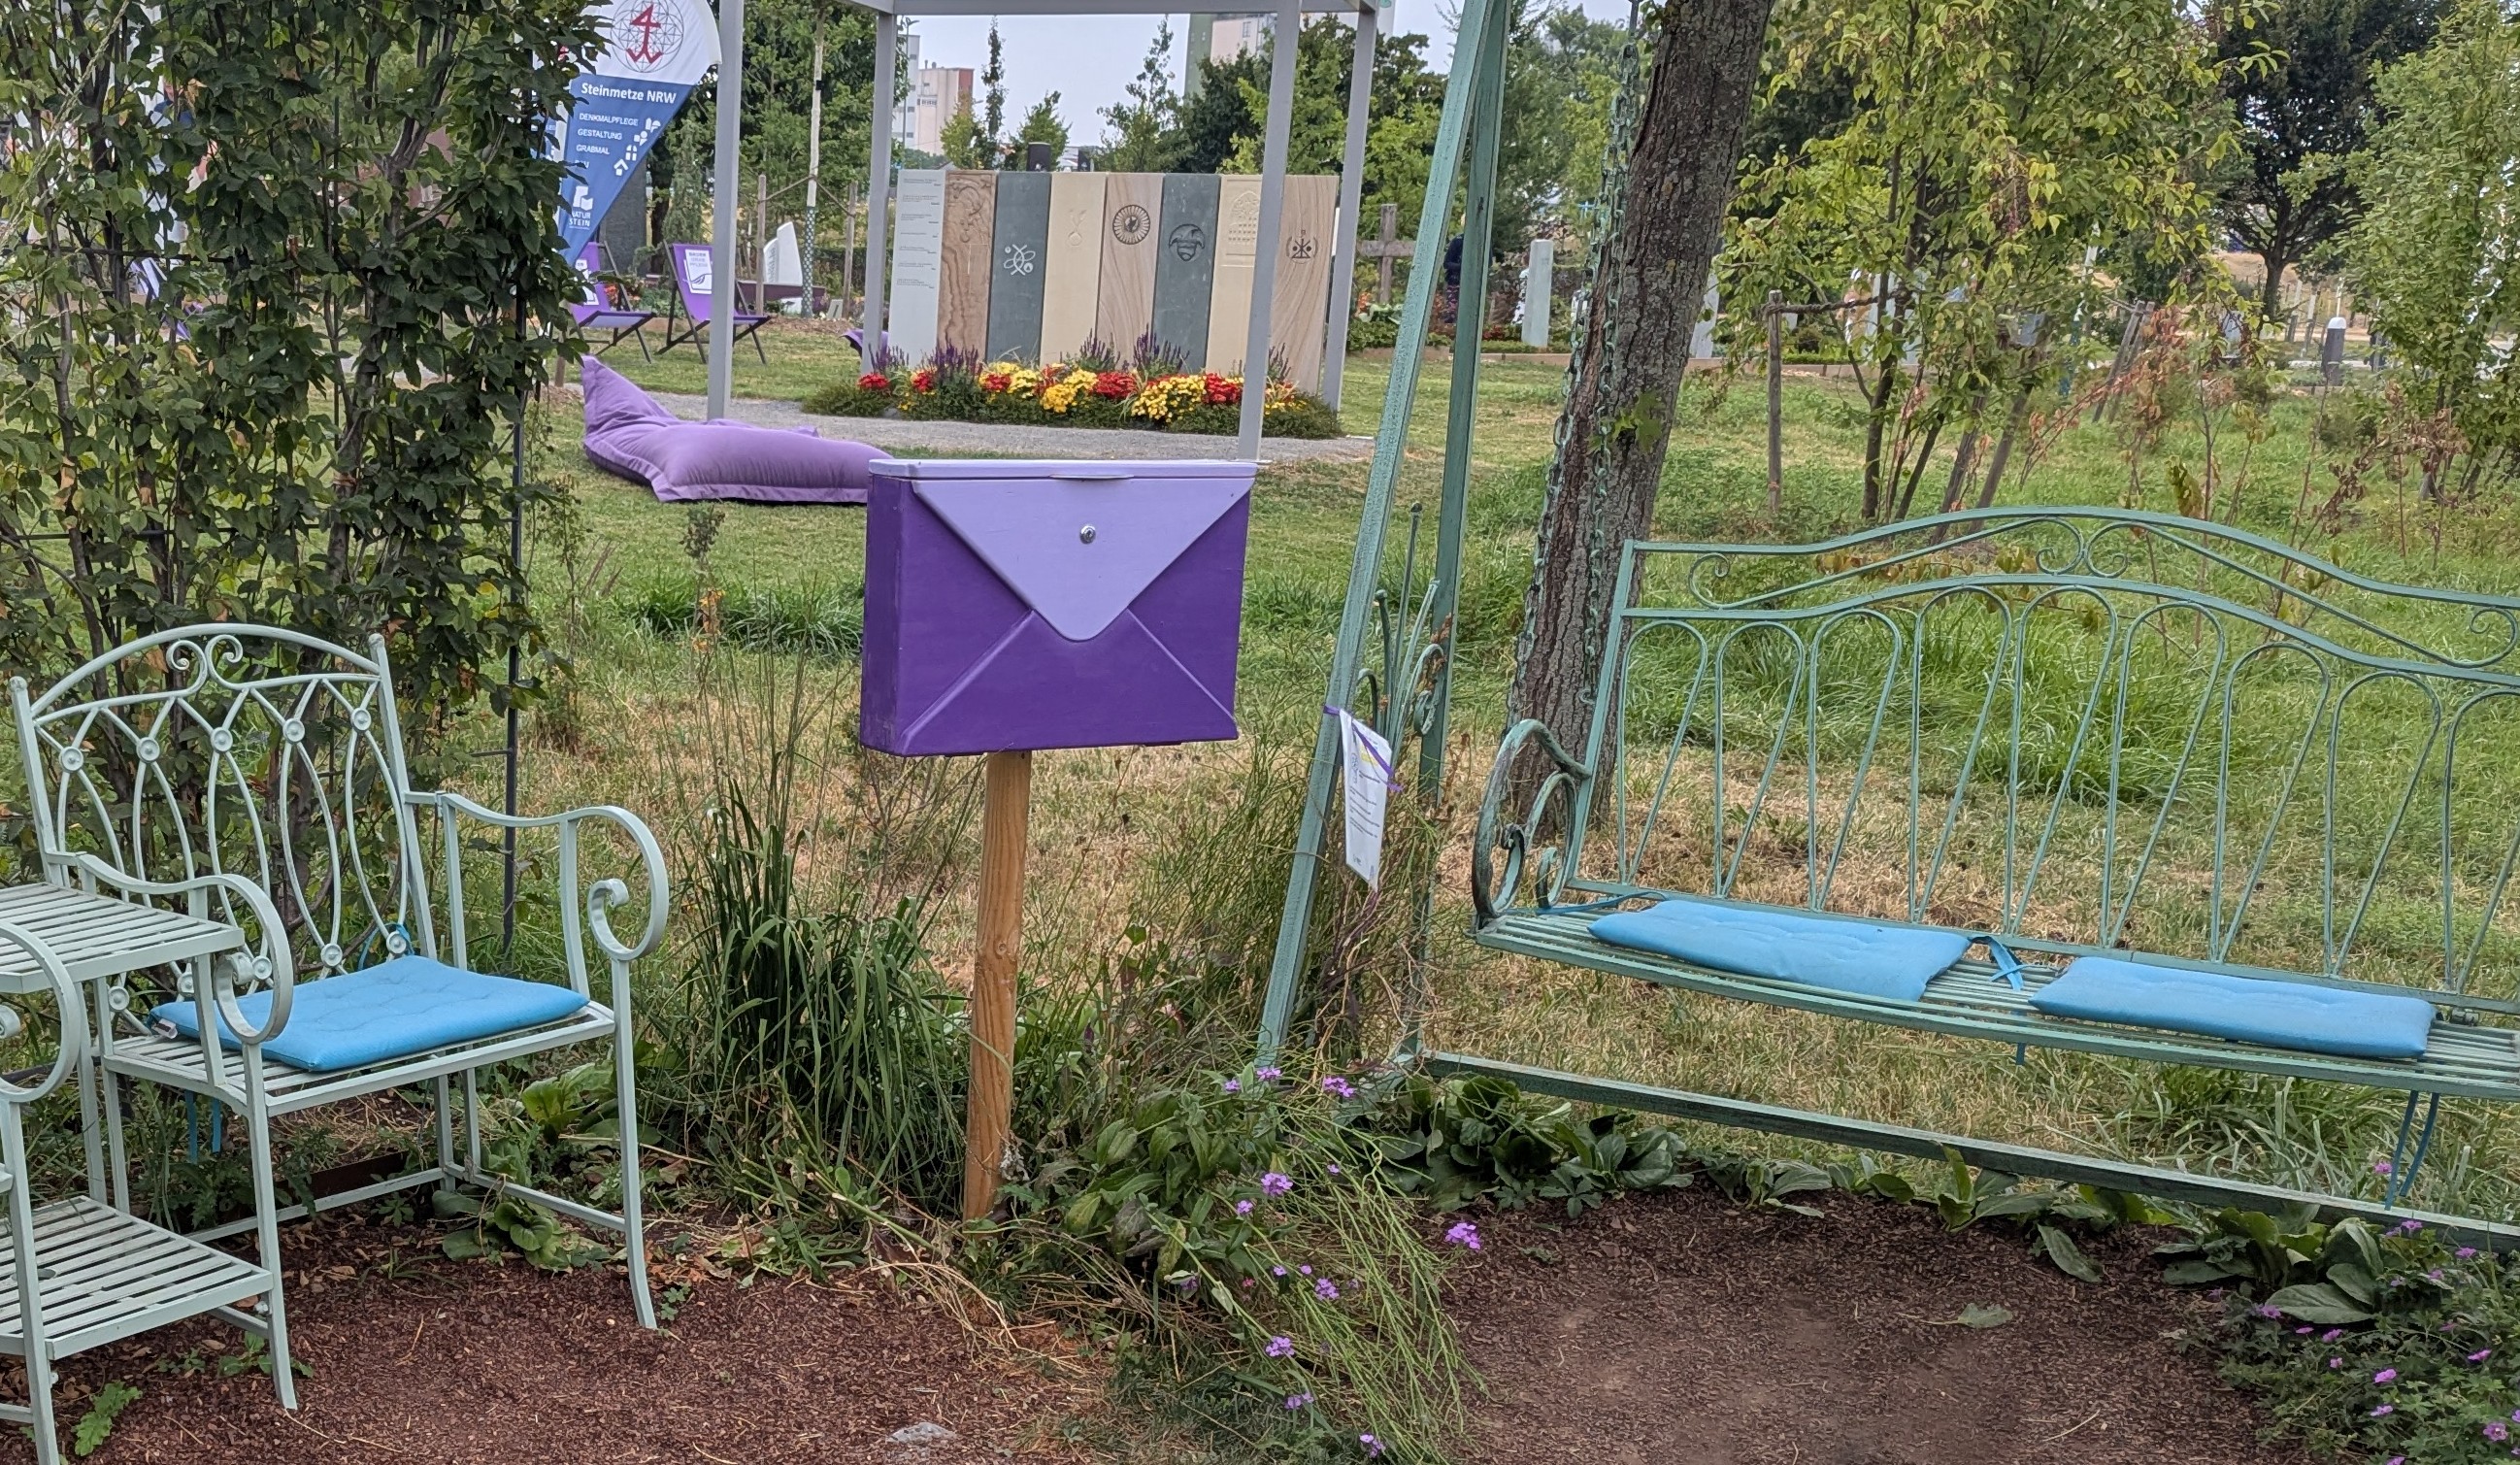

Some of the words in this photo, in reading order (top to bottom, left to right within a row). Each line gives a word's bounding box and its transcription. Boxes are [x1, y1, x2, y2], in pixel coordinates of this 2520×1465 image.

[580, 83, 645, 101] Steinmetze
[647, 90, 677, 104] NRW
[579, 113, 639, 127] DENKMALPFLEGE
[578, 128, 622, 140] GESTALTUNG
[576, 145, 610, 154] GRABMAL
[569, 218, 590, 227] STEIN
